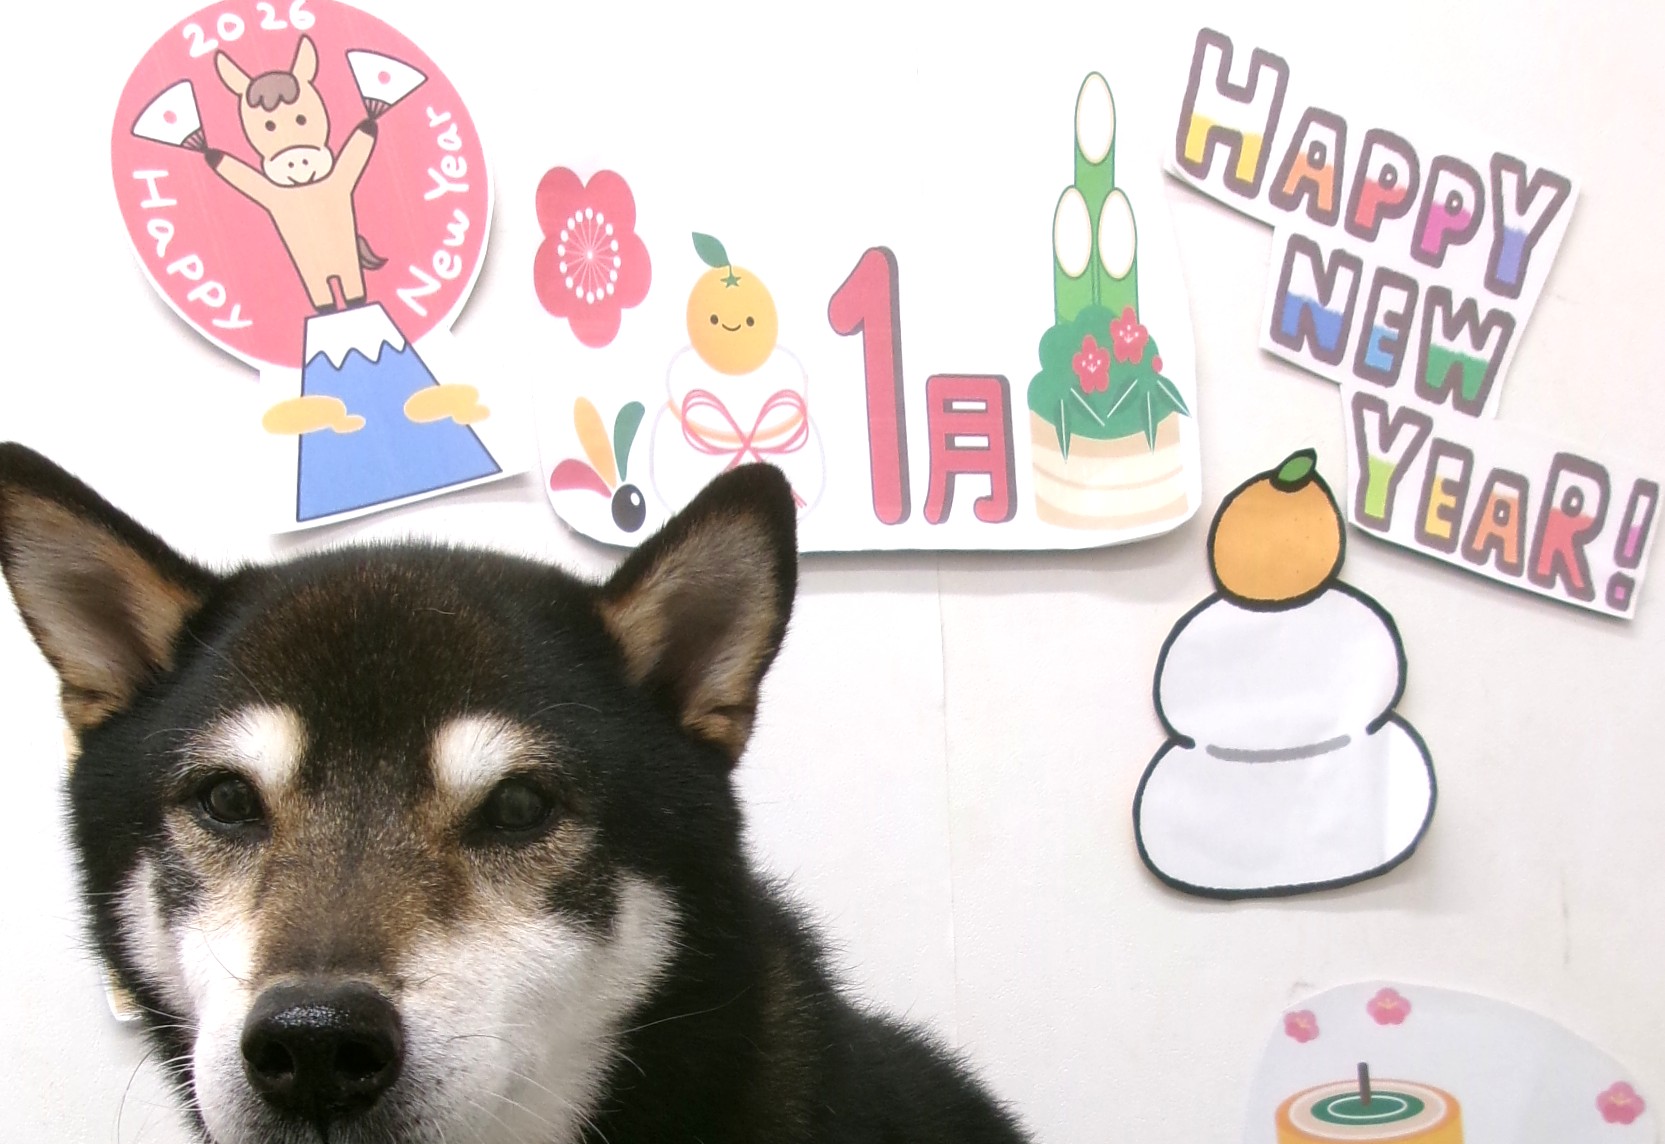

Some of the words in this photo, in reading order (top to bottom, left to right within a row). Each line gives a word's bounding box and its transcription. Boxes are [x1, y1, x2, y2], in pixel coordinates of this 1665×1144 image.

[182, 0, 316, 58] 2026
[423, 106, 470, 202] Year
[1175, 26, 1572, 300] HAPPY
[131, 169, 254, 330] Happy
[395, 209, 471, 318] New
[1269, 232, 1517, 418] NEW
[827, 245, 1018, 526] 1月
[1352, 391, 1660, 612] YEAR!
